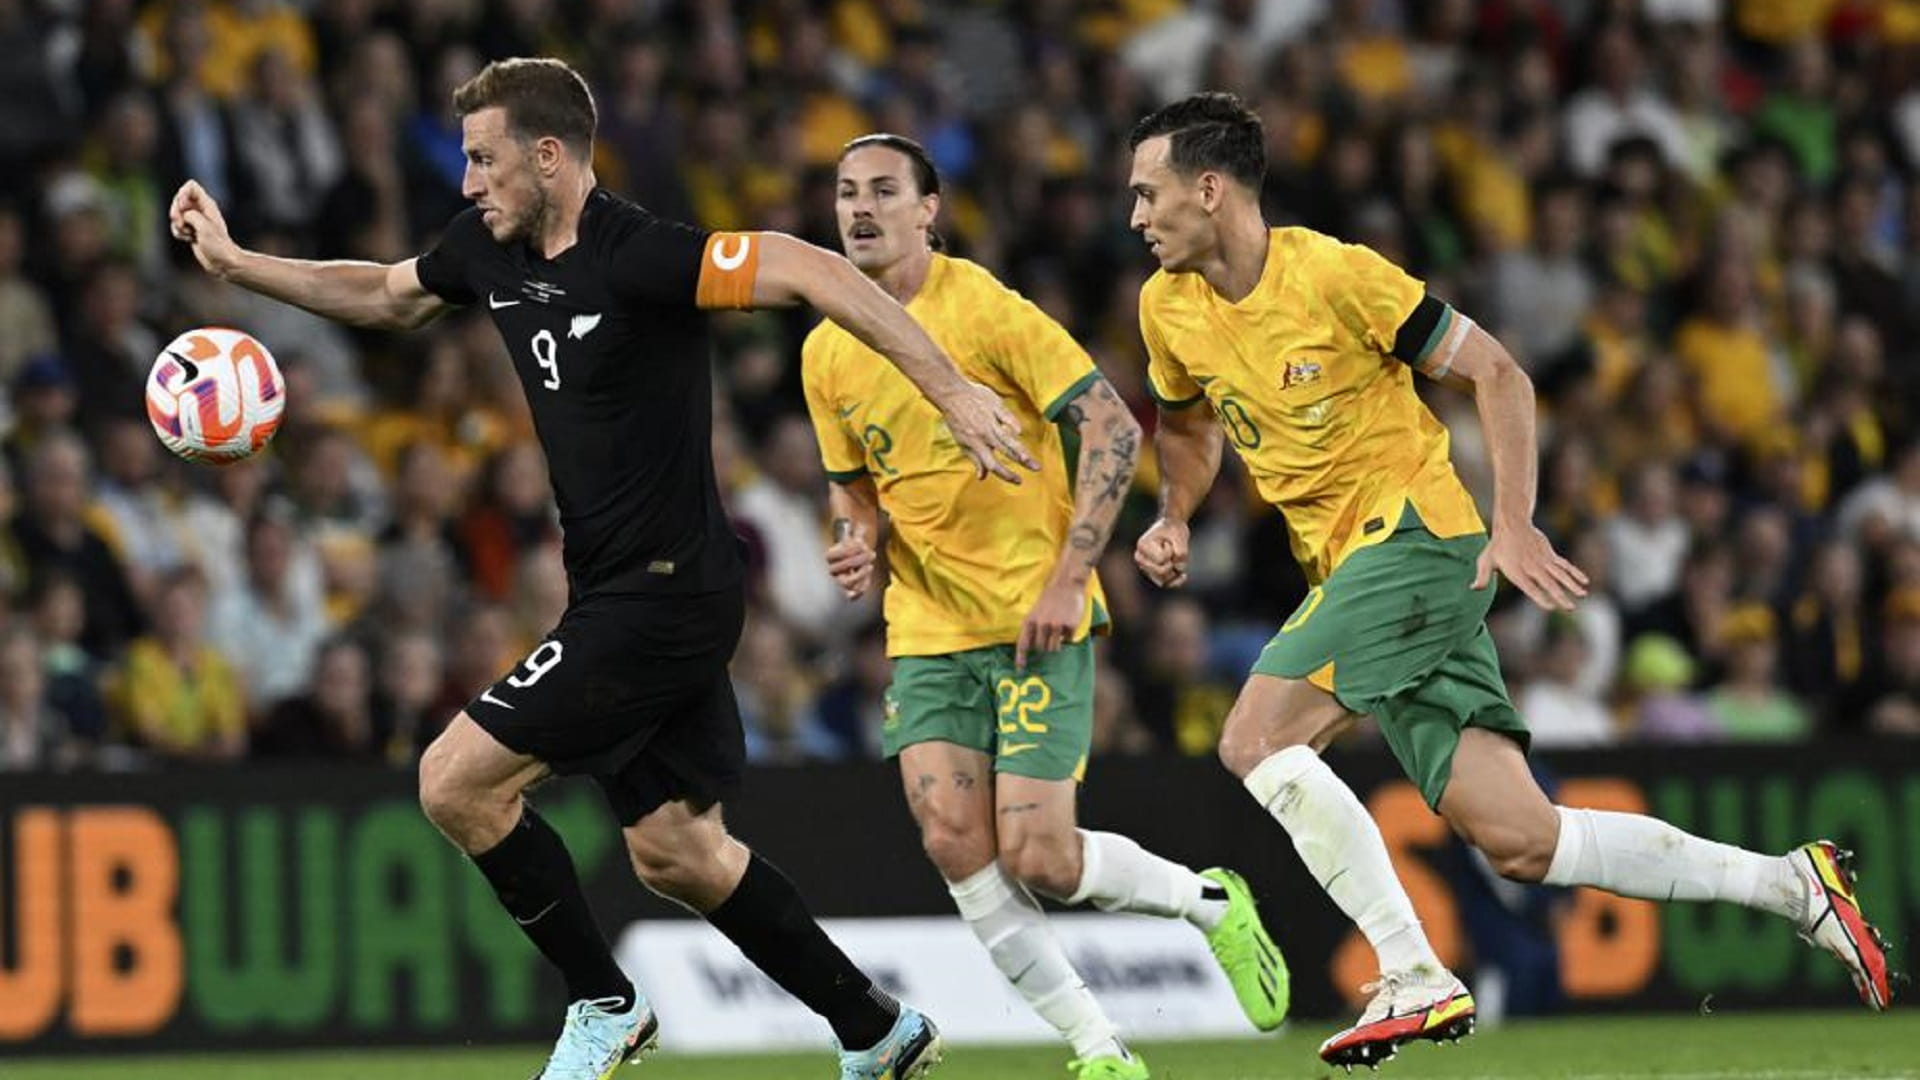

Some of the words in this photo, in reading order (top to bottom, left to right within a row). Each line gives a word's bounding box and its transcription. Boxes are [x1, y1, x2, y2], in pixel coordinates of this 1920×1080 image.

[531, 329, 562, 391] 9
[506, 640, 564, 688] 9
[997, 677, 1051, 733] 22
